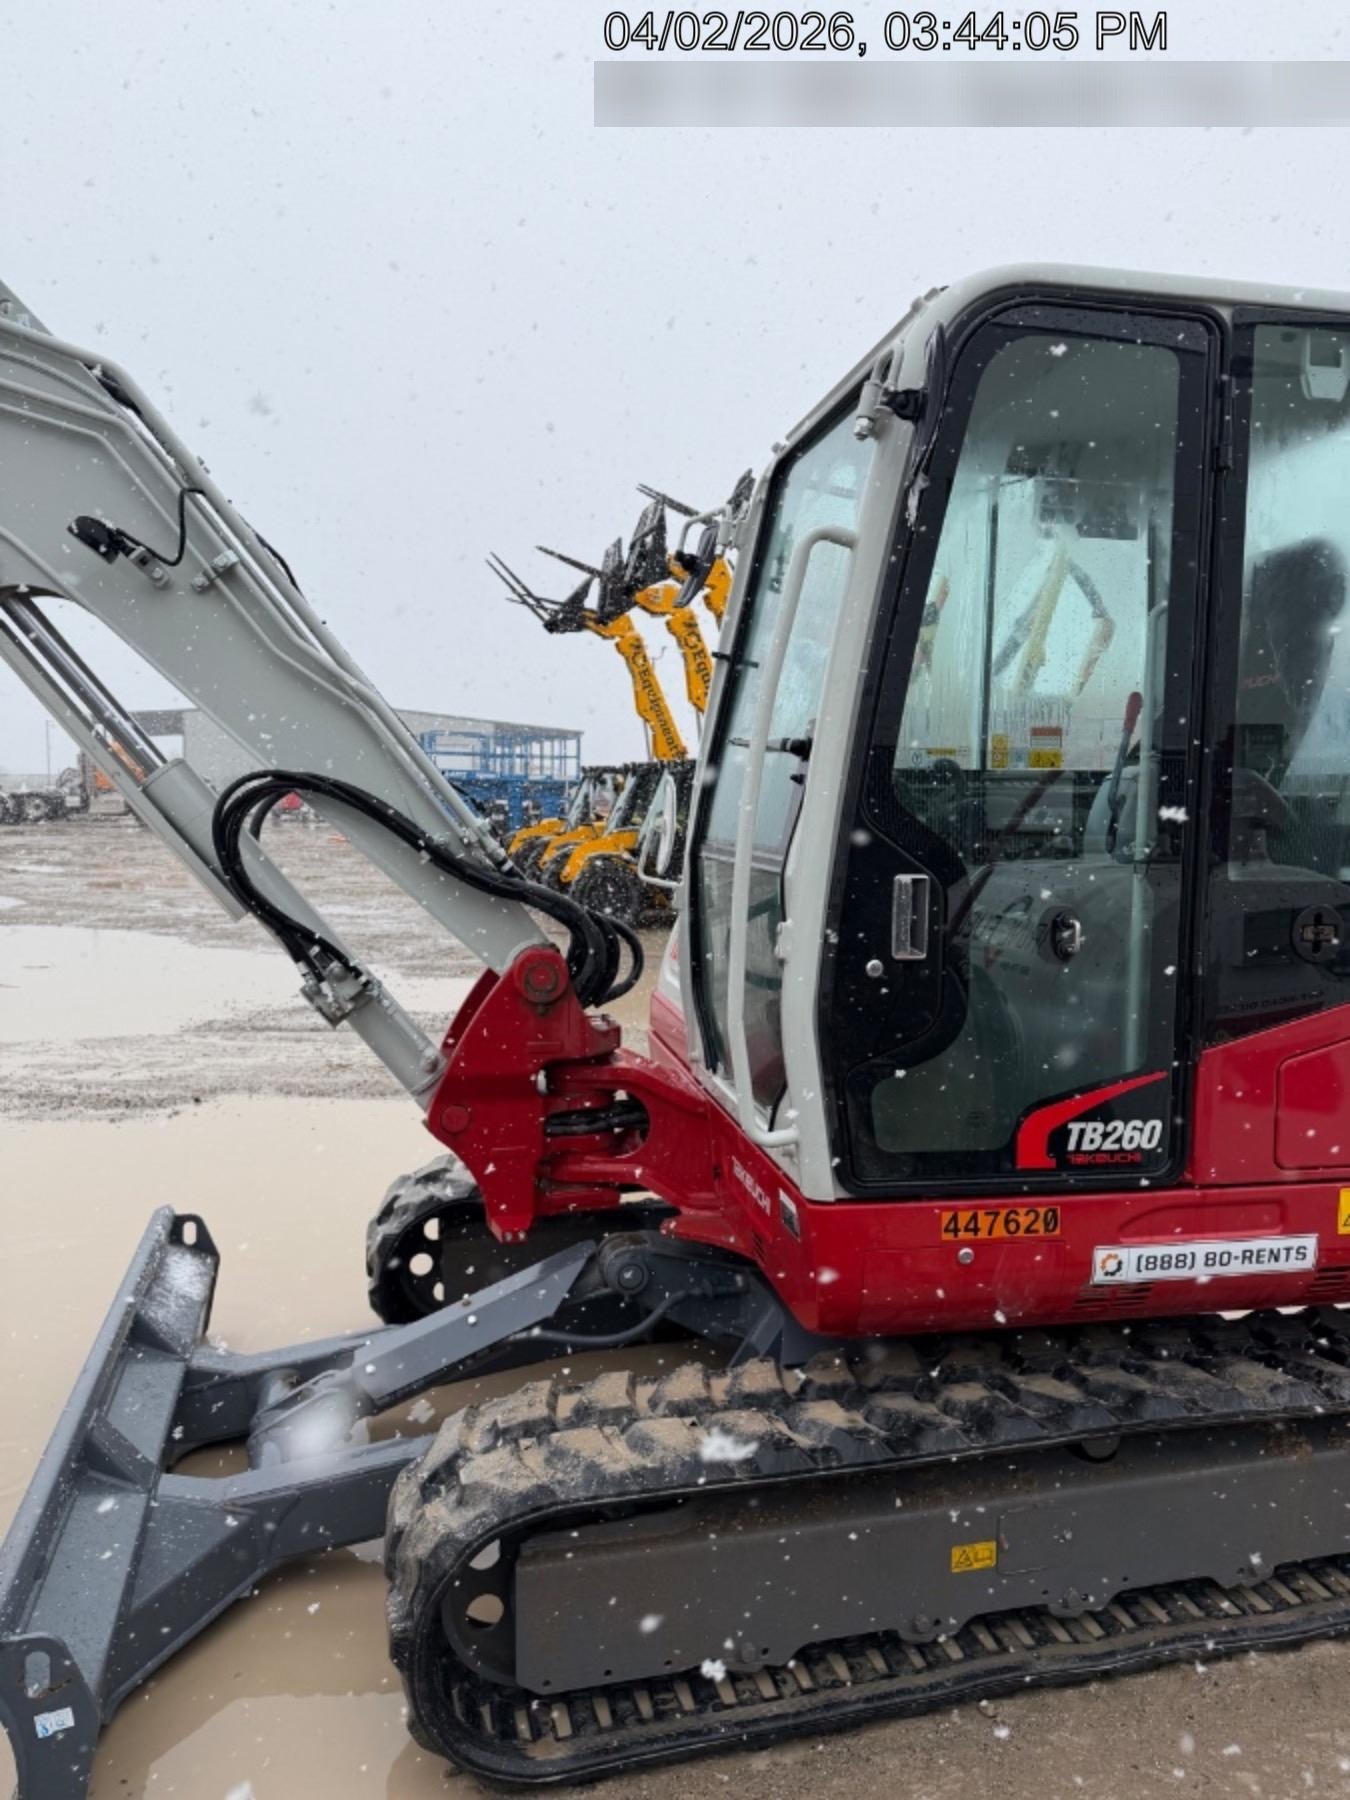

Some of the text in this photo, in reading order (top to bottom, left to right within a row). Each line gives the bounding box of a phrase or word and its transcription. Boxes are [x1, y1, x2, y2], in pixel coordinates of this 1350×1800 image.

[1066, 1119, 1163, 1151] TB260
[943, 1207, 1059, 1238] 447620
[1135, 1251, 1197, 1273] (888)
